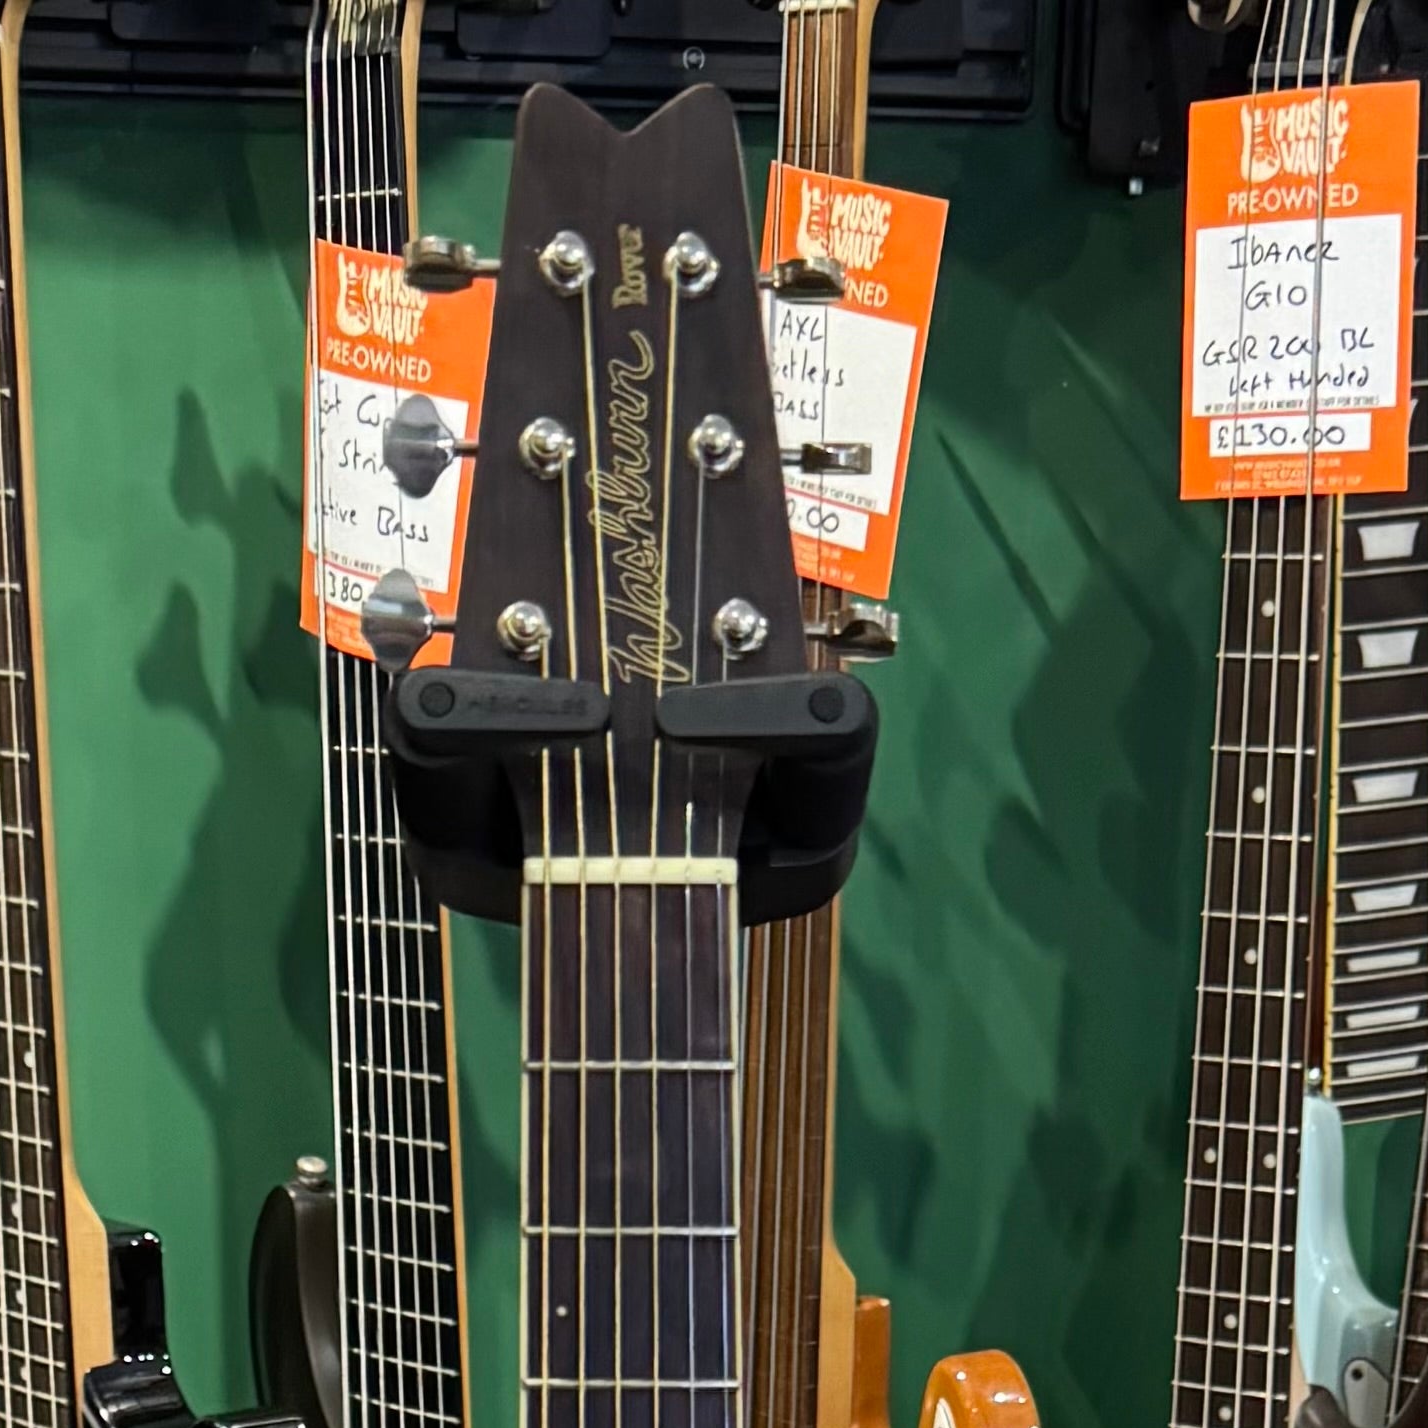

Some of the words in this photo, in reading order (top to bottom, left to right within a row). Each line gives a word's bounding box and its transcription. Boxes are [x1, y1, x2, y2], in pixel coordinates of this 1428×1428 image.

[1277, 96, 1349, 141] MUSIC
[1281, 138, 1343, 178] VAULT
[831, 193, 892, 236] MUSIC
[834, 226, 886, 271] VAULT
[370, 303, 422, 345] VAULT
[326, 338, 432, 384] PRE-OWNED
[1217, 423, 1345, 449] £130.00
[588, 329, 692, 685] Washburn
